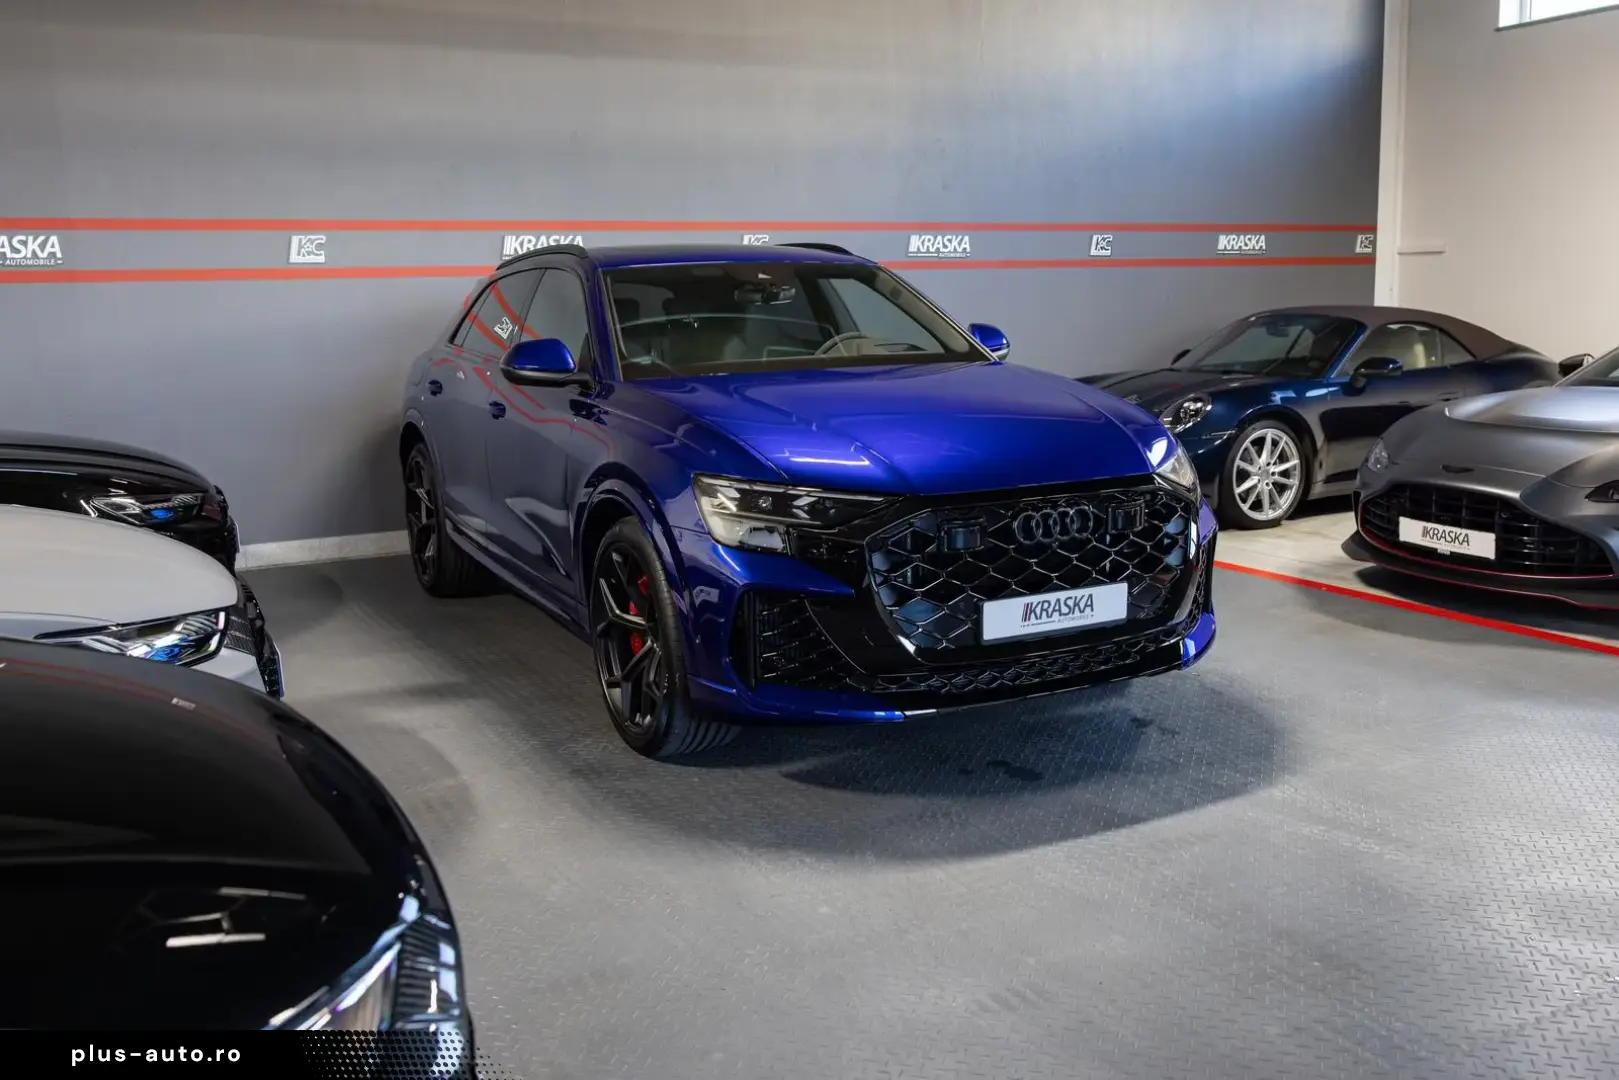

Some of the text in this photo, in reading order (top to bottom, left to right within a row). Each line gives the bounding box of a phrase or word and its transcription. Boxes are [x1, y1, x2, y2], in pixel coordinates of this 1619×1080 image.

[912, 235, 971, 252] KRASKA
[1220, 234, 1266, 250] KRASKA
[1427, 525, 1470, 547] KRASKA
[1027, 593, 1095, 622] KRASKA
